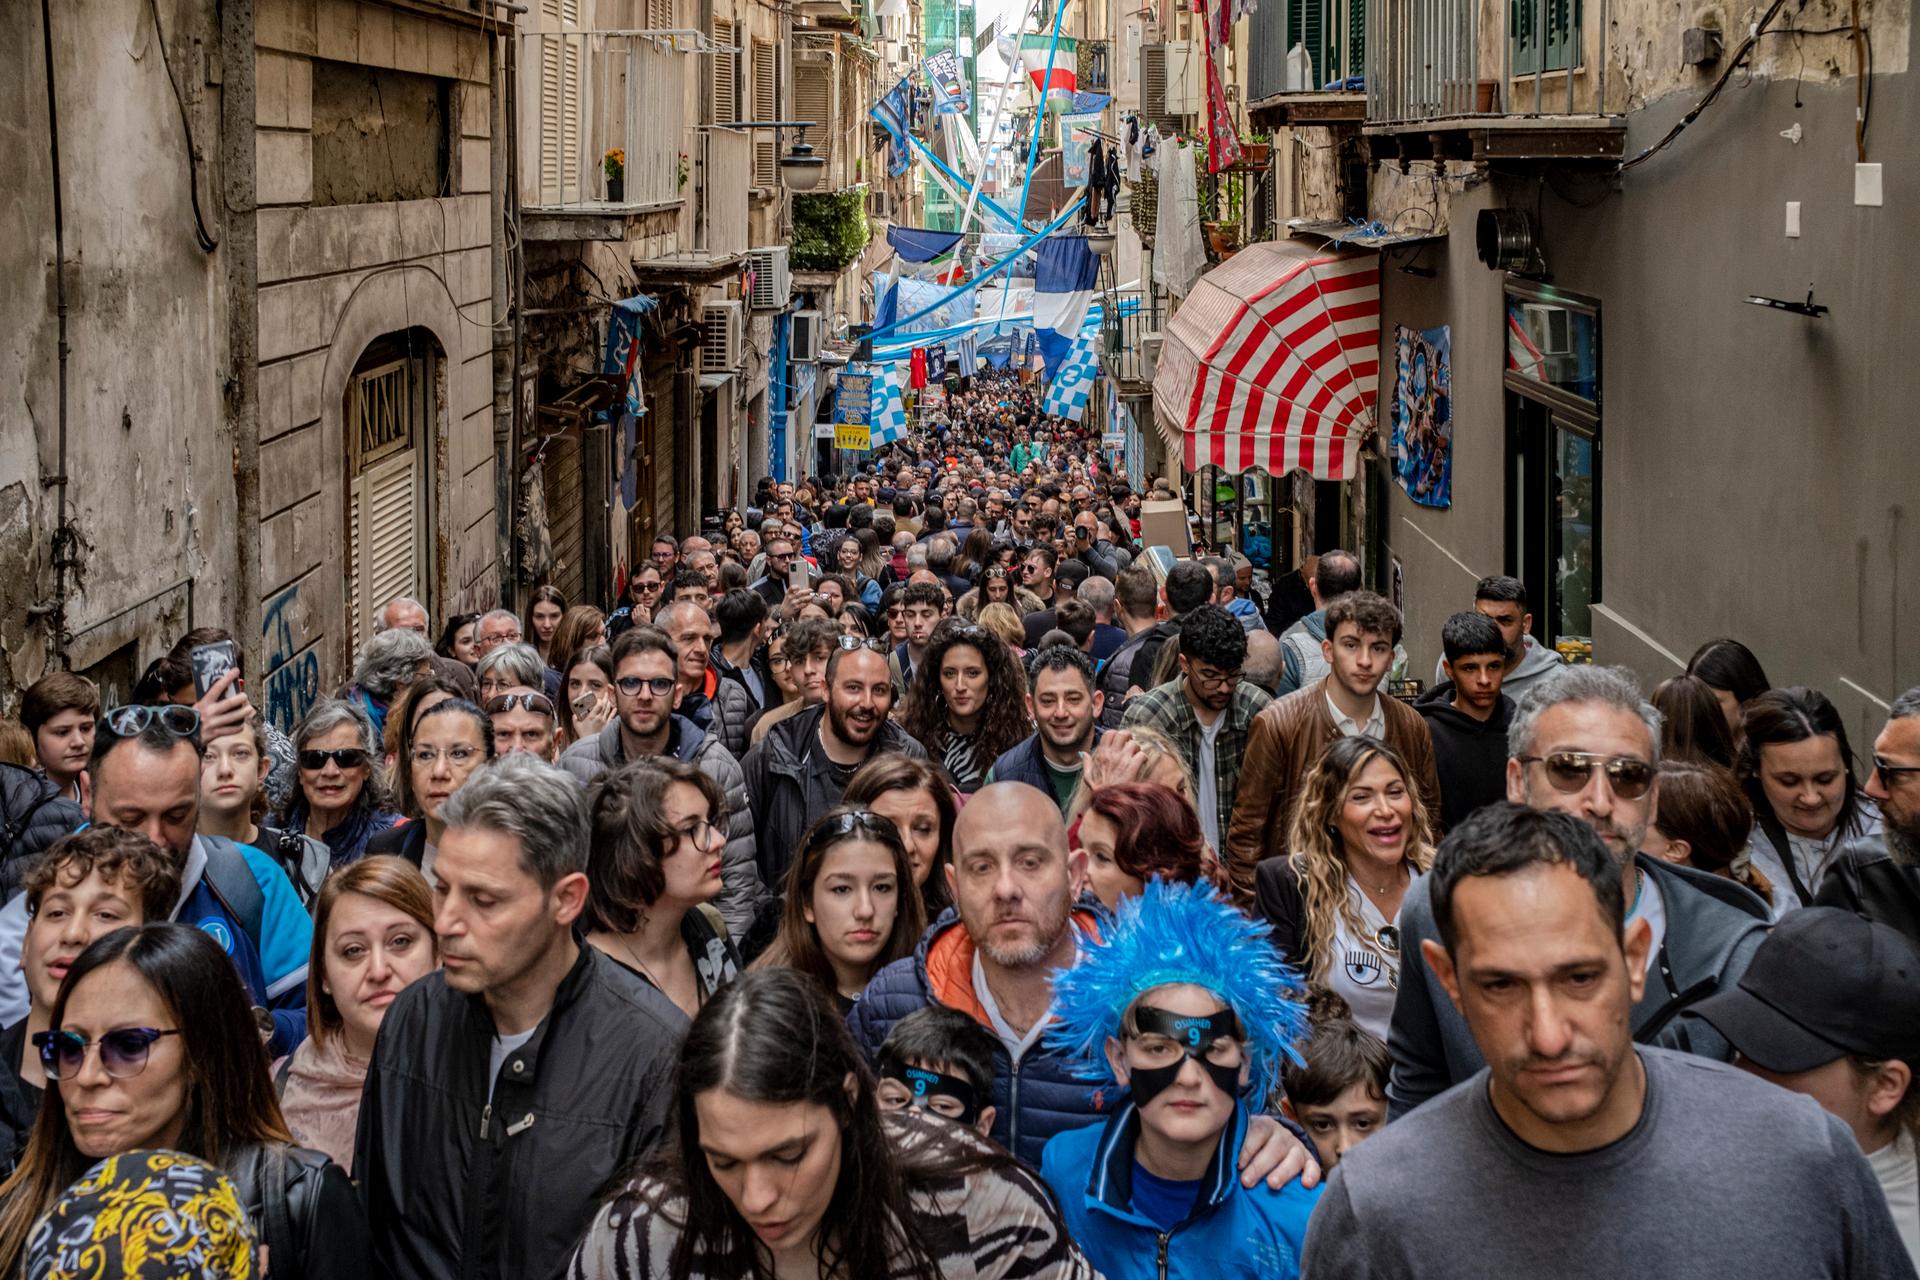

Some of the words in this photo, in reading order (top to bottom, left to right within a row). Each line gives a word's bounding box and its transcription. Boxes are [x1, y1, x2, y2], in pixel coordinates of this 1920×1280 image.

[926, 58, 943, 77] FINE
[934, 54, 955, 80] SENZA
[1174, 1018, 1211, 1030] OSIMHEN
[1188, 1027, 1200, 1046] 9
[906, 1069, 939, 1085] OSIMHEN
[914, 1079, 926, 1097] 9
